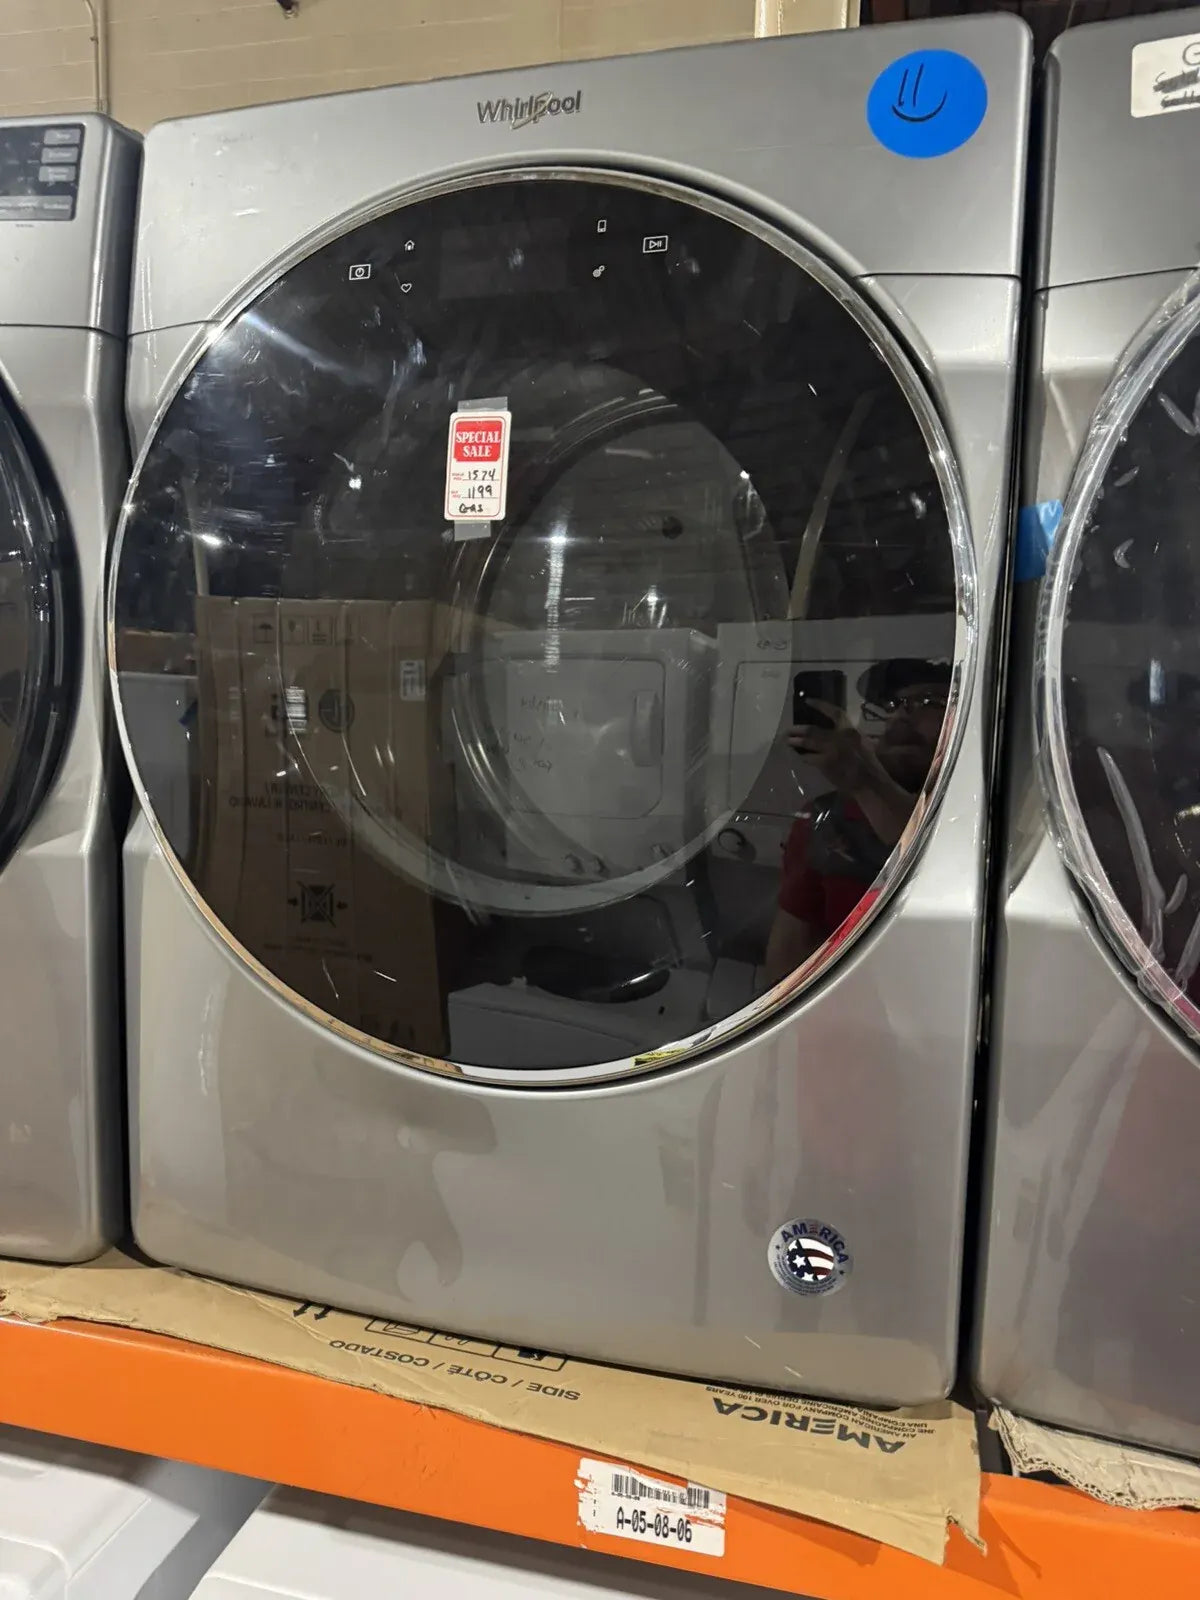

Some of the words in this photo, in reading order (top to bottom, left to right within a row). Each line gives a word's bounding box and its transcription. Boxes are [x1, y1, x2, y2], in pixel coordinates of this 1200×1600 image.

[477, 90, 581, 124] Whirlpool
[455, 430, 501, 443] SPECIAL
[463, 445, 492, 458] SALE
[468, 468, 496, 481] 1574
[468, 485, 493, 499] 1199
[781, 1222, 849, 1264] AMERICA
[329, 1340, 430, 1367] COSTADO
[432, 1362, 445, 1370] /
[447, 1363, 508, 1384] CÔTÉ
[511, 1379, 524, 1388] /
[526, 1382, 581, 1401] SIDE
[705, 1386, 737, 1397] YEARS
[738, 1393, 753, 1401] 100
[754, 1397, 780, 1406] OVER
[782, 1402, 802, 1411] FOR
[802, 1407, 850, 1421] COMPANY
[713, 1398, 906, 1454] AMERICA
[851, 1417, 900, 1437] AMERICAN
[616, 1506, 693, 1543] A-05-08-06
